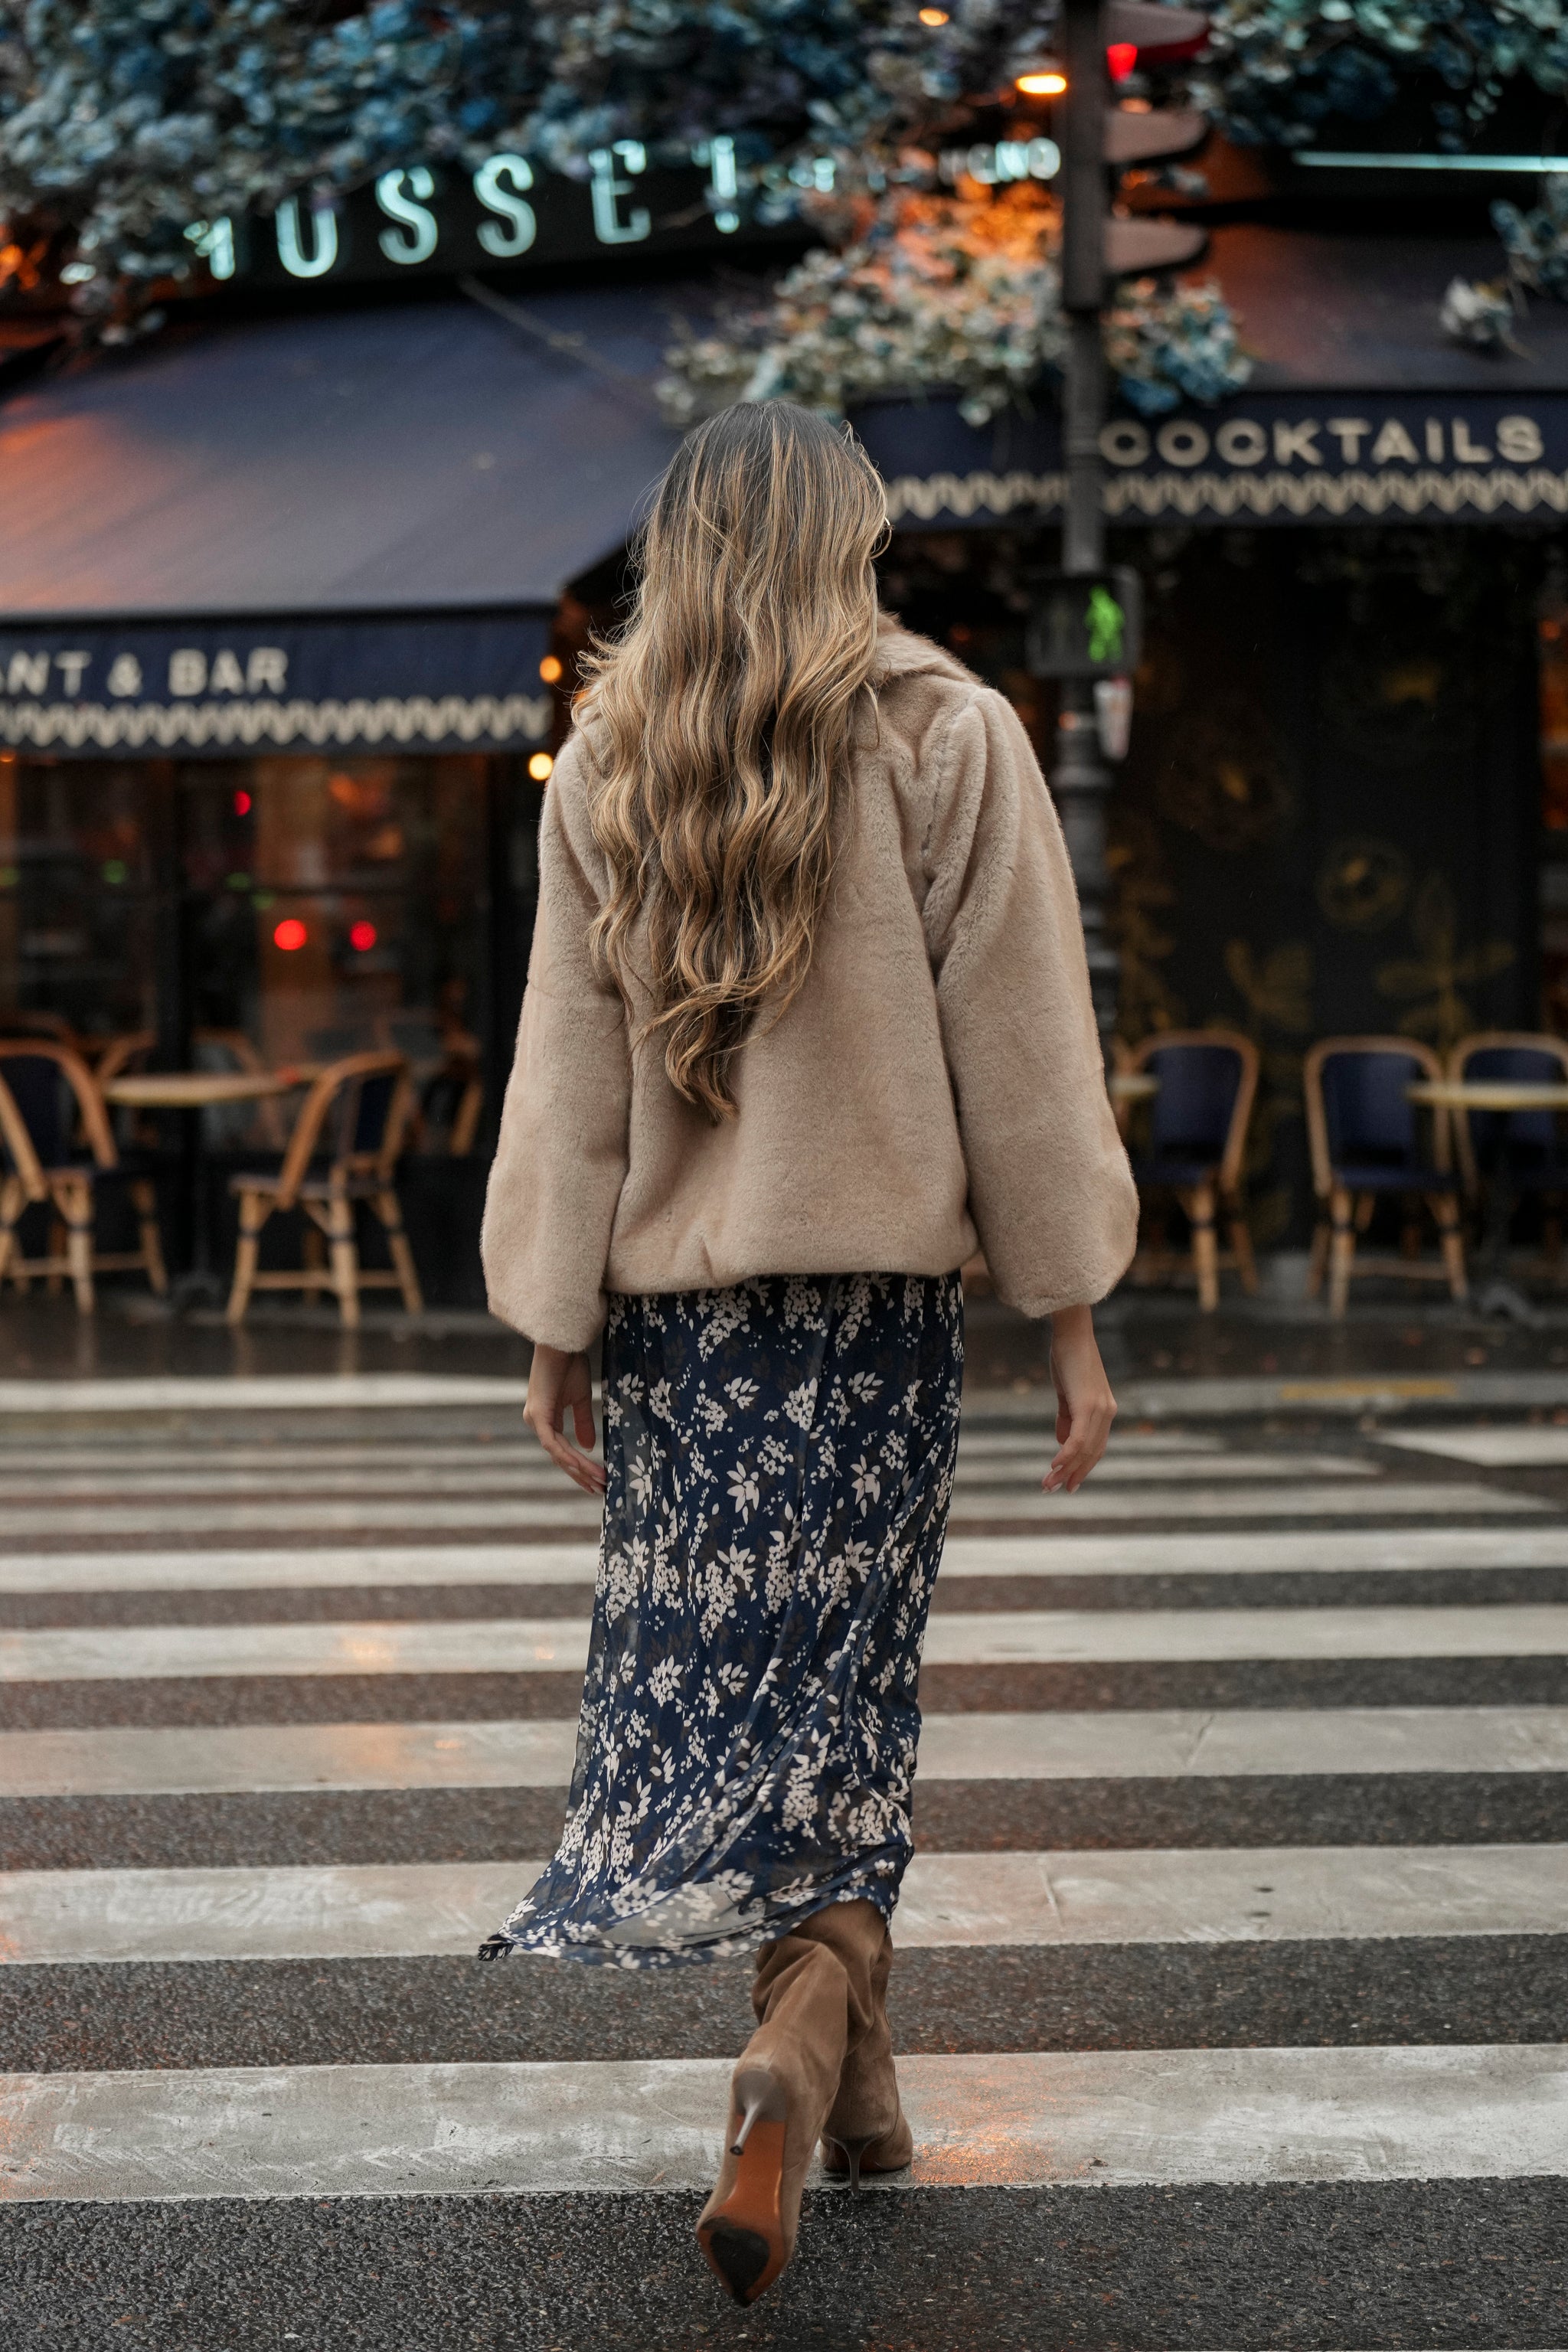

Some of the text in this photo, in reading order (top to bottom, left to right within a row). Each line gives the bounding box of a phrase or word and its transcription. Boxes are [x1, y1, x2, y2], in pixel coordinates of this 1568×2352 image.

[1098, 416, 1544, 467] COCKTAILS
[0, 646, 289, 697] NT & BAR
